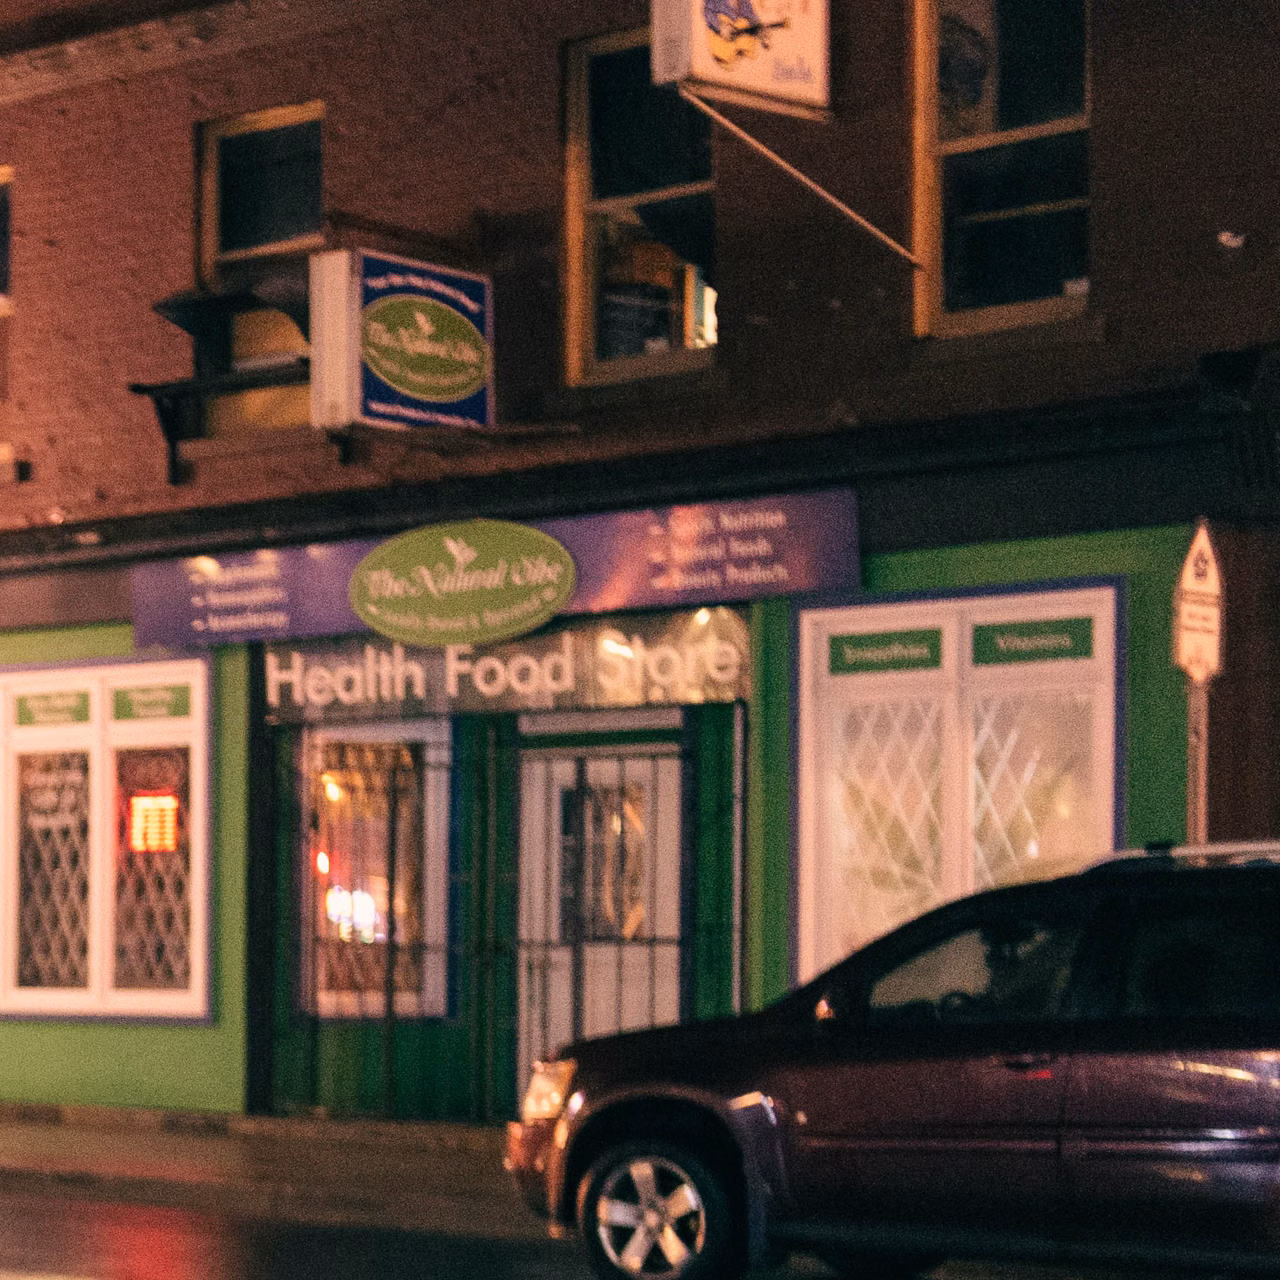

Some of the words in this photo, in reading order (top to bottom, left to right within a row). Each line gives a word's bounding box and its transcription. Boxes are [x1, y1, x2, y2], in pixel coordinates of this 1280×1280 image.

[265, 643, 425, 707] Health
[445, 633, 574, 697] Food
[597, 627, 741, 694] Store
